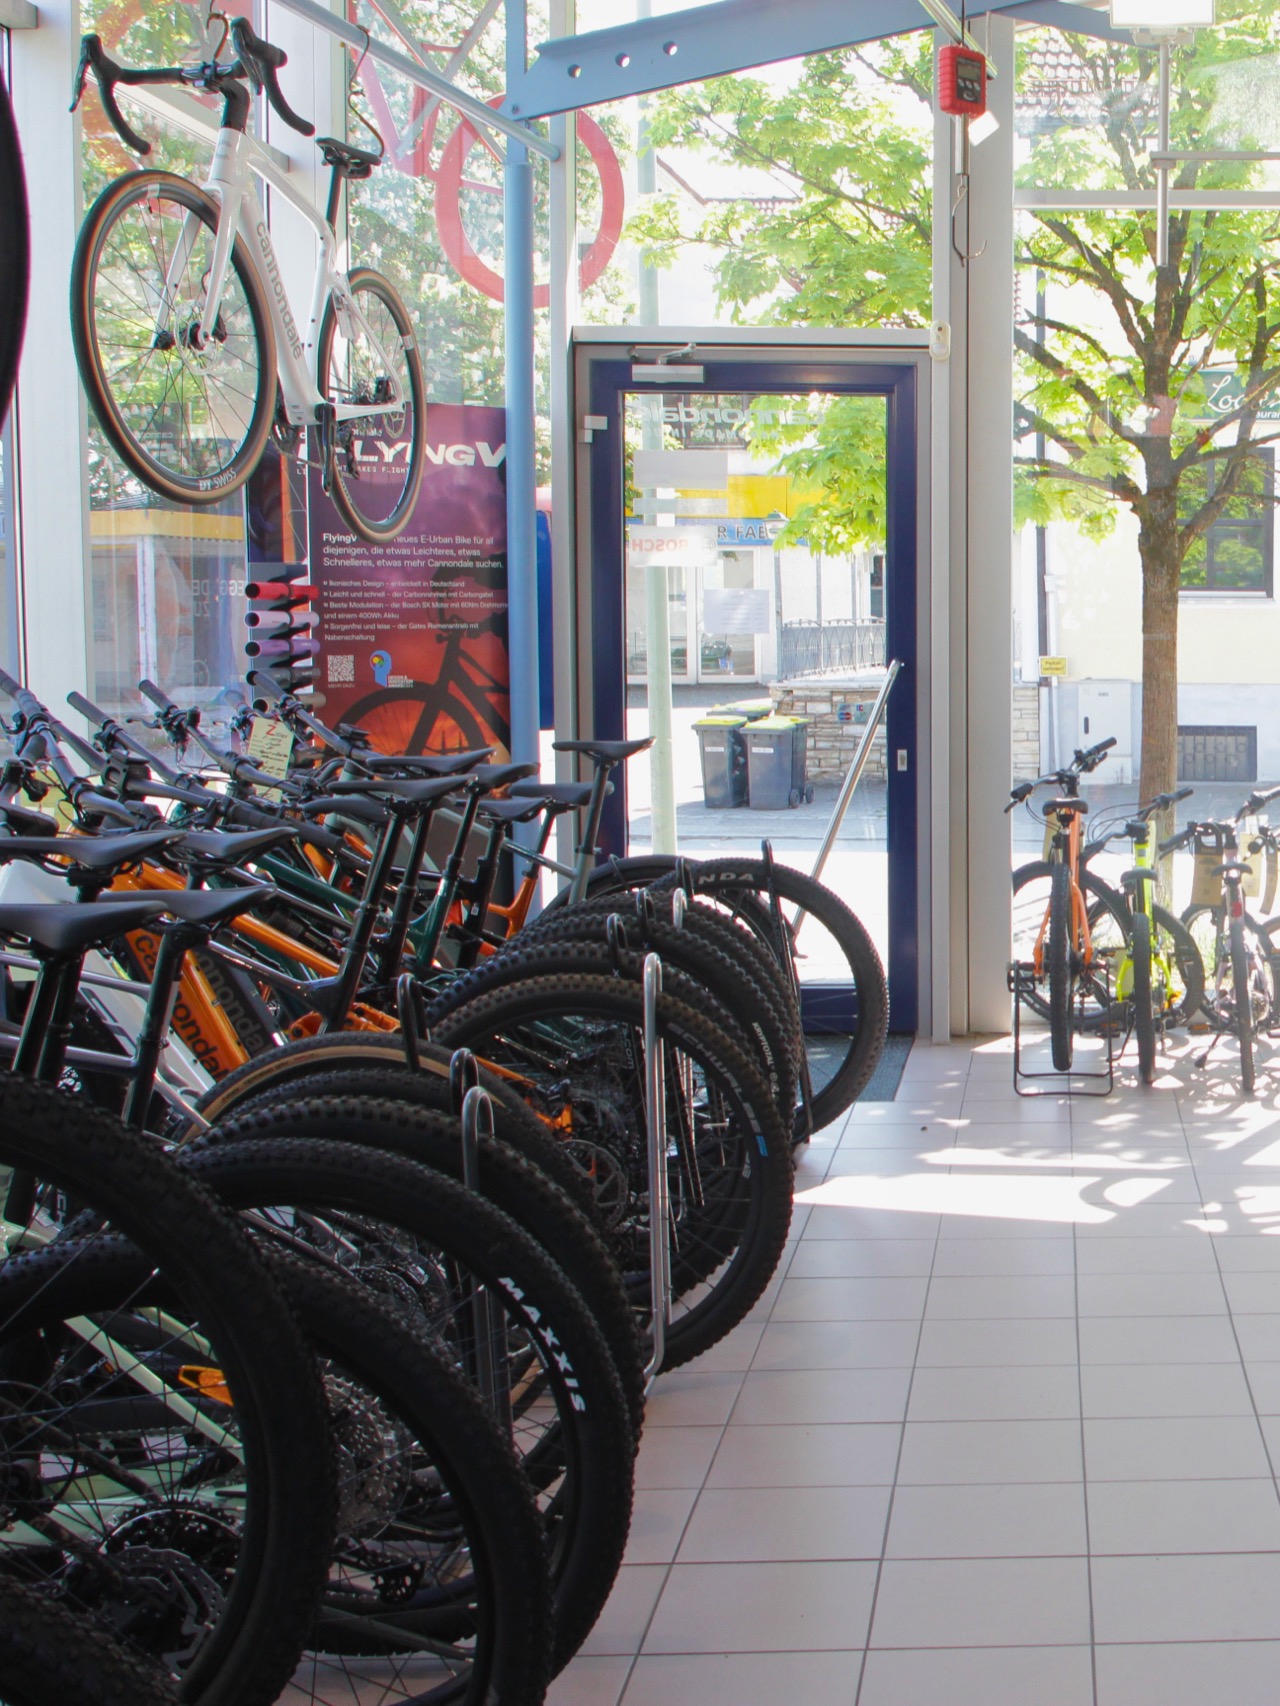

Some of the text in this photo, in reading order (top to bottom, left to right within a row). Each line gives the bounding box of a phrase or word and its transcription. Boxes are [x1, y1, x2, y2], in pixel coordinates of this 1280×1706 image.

[256, 221, 301, 360] cannondale
[199, 468, 237, 491] DT SWISS
[323, 533, 357, 544] FlyingV
[420, 535, 453, 544] E-Urban
[455, 536, 472, 544] Bike
[473, 536, 484, 545] für
[323, 546, 369, 556] diejenigen,
[386, 547, 411, 555] etwas
[413, 547, 456, 556] Leichteres,
[323, 558, 504, 568] Schnelleres, etwas mehr Cannondale suchen.
[363, 580, 385, 589] Design
[430, 580, 465, 588] Deutschland
[330, 623, 362, 632] Sorgenfrei
[324, 634, 376, 642] Nabenschaltung
[498, 1276, 586, 1412] MAXXIS
